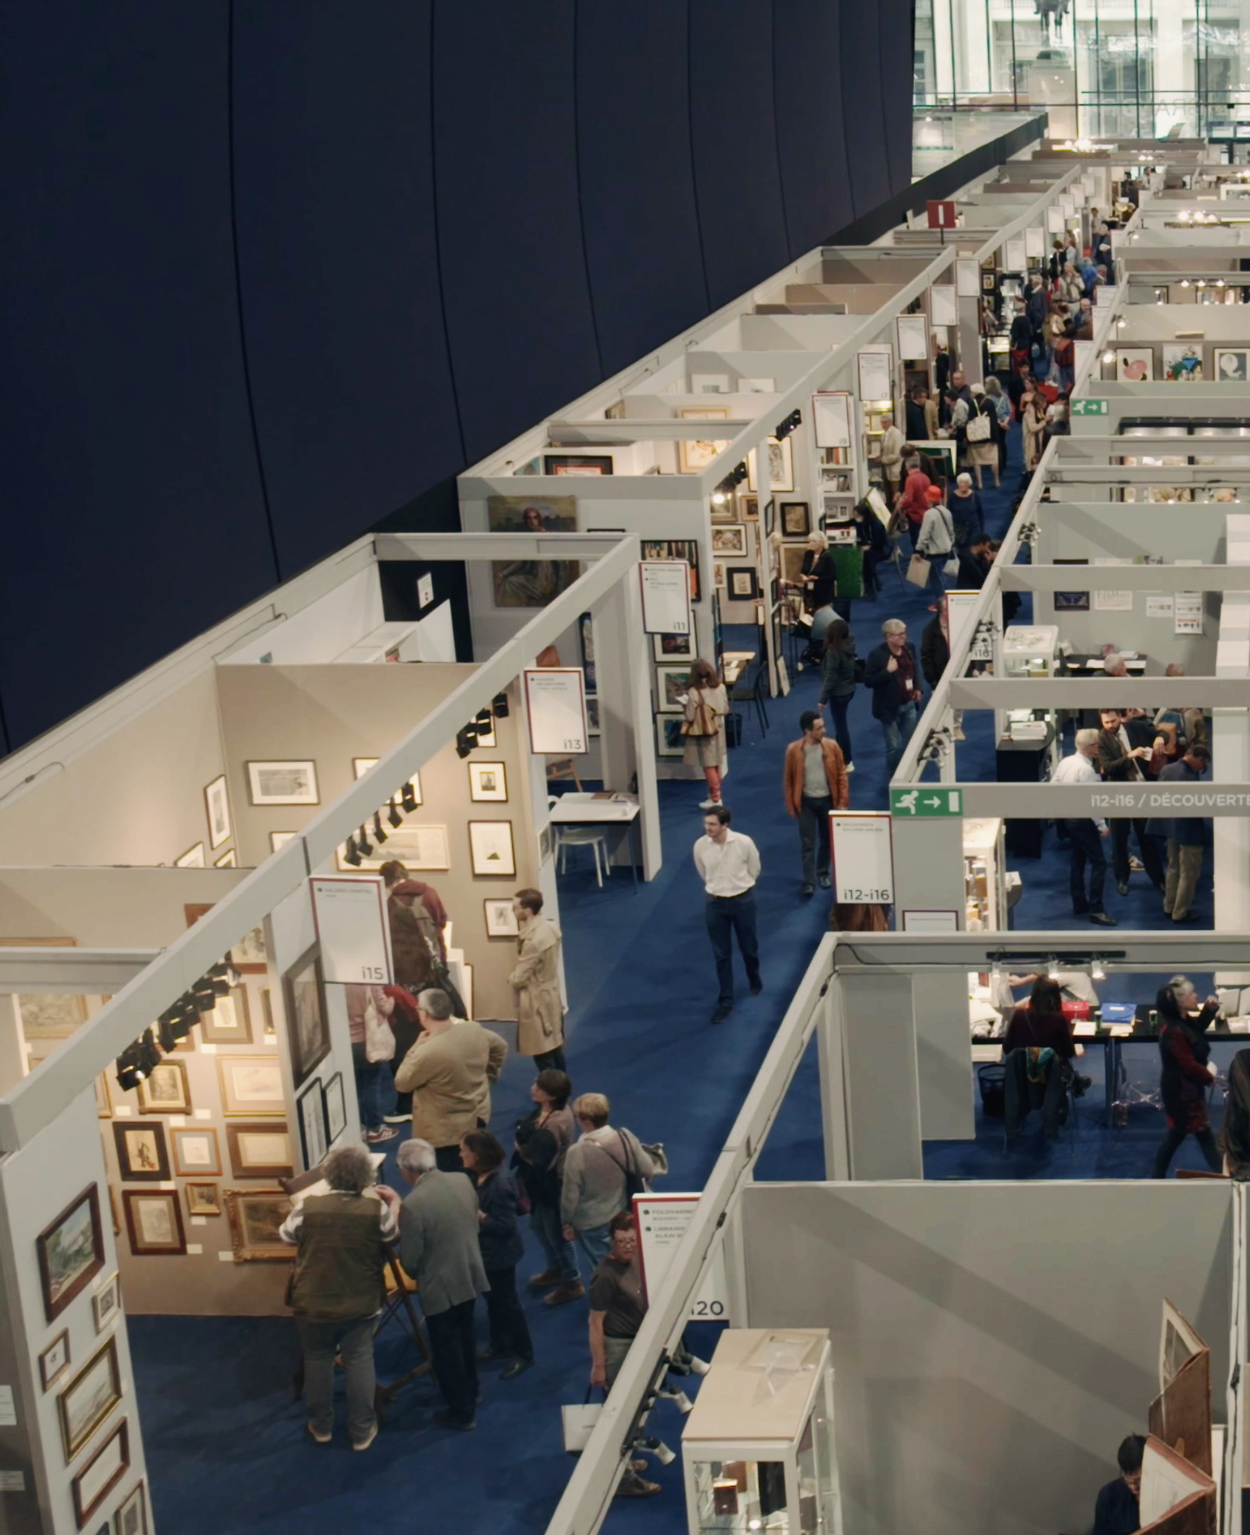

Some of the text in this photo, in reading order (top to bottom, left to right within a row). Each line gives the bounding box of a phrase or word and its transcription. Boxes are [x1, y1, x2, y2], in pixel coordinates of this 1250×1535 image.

[564, 739, 582, 750] i13
[1091, 793, 1135, 807] i12-i16
[1137, 793, 1147, 808] /
[843, 888, 890, 901] i12-i16
[362, 966, 384, 980] i15
